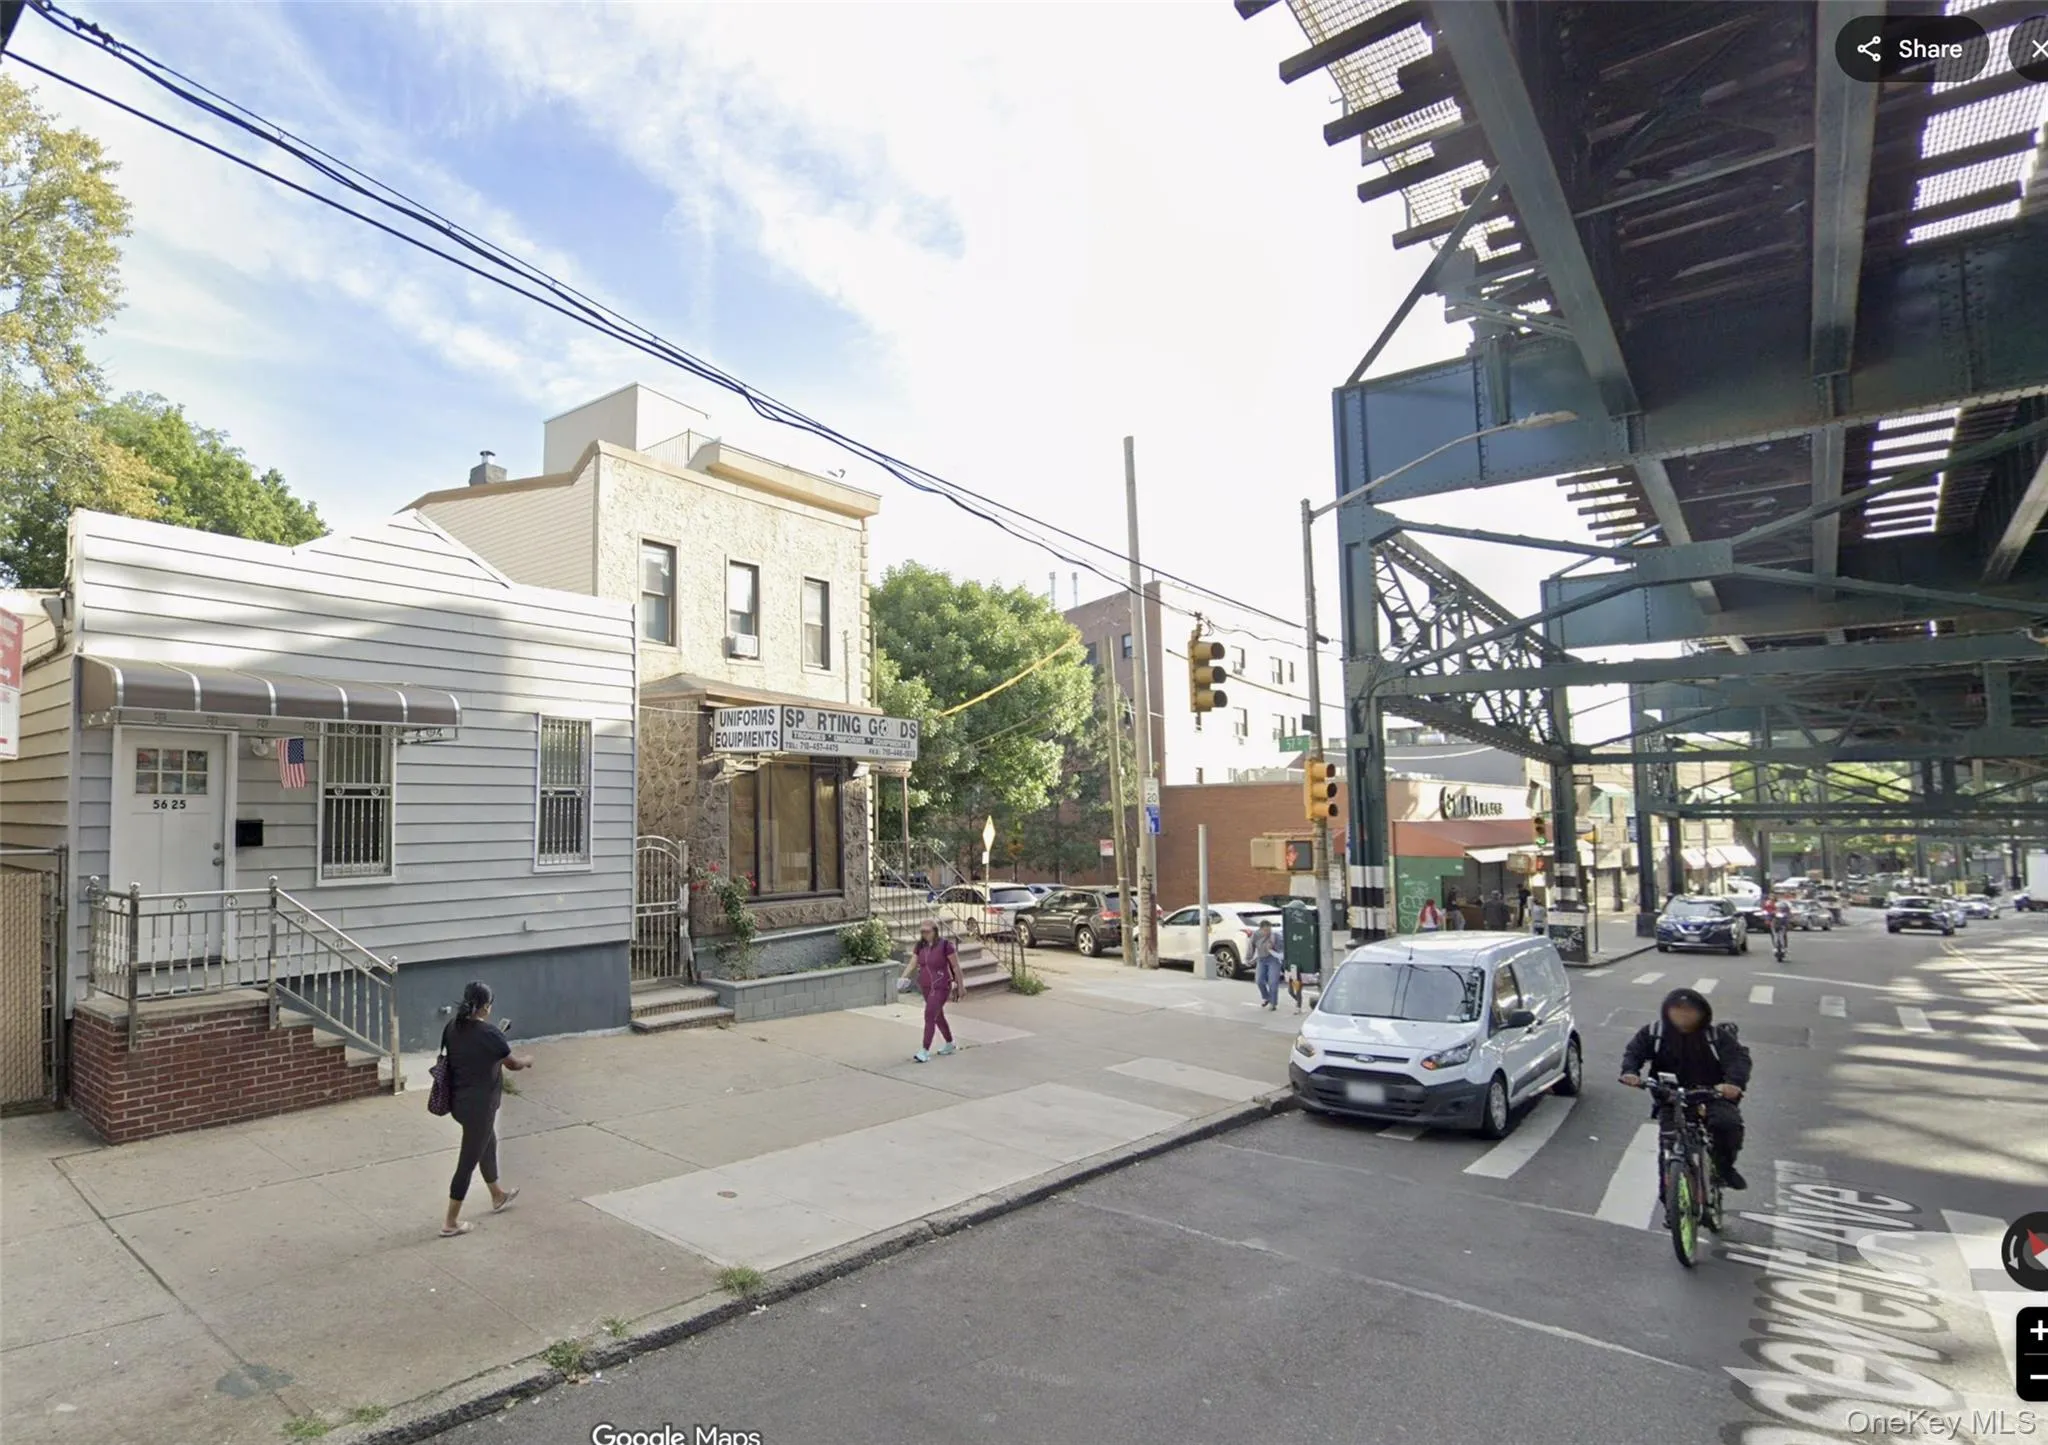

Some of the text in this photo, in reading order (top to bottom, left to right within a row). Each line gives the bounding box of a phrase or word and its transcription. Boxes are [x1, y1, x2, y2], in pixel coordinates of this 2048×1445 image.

[720, 709, 775, 727] UNIFORMS
[785, 708, 917, 739] SPRTING GODS
[715, 730, 778, 748] EQUIPMENTS
